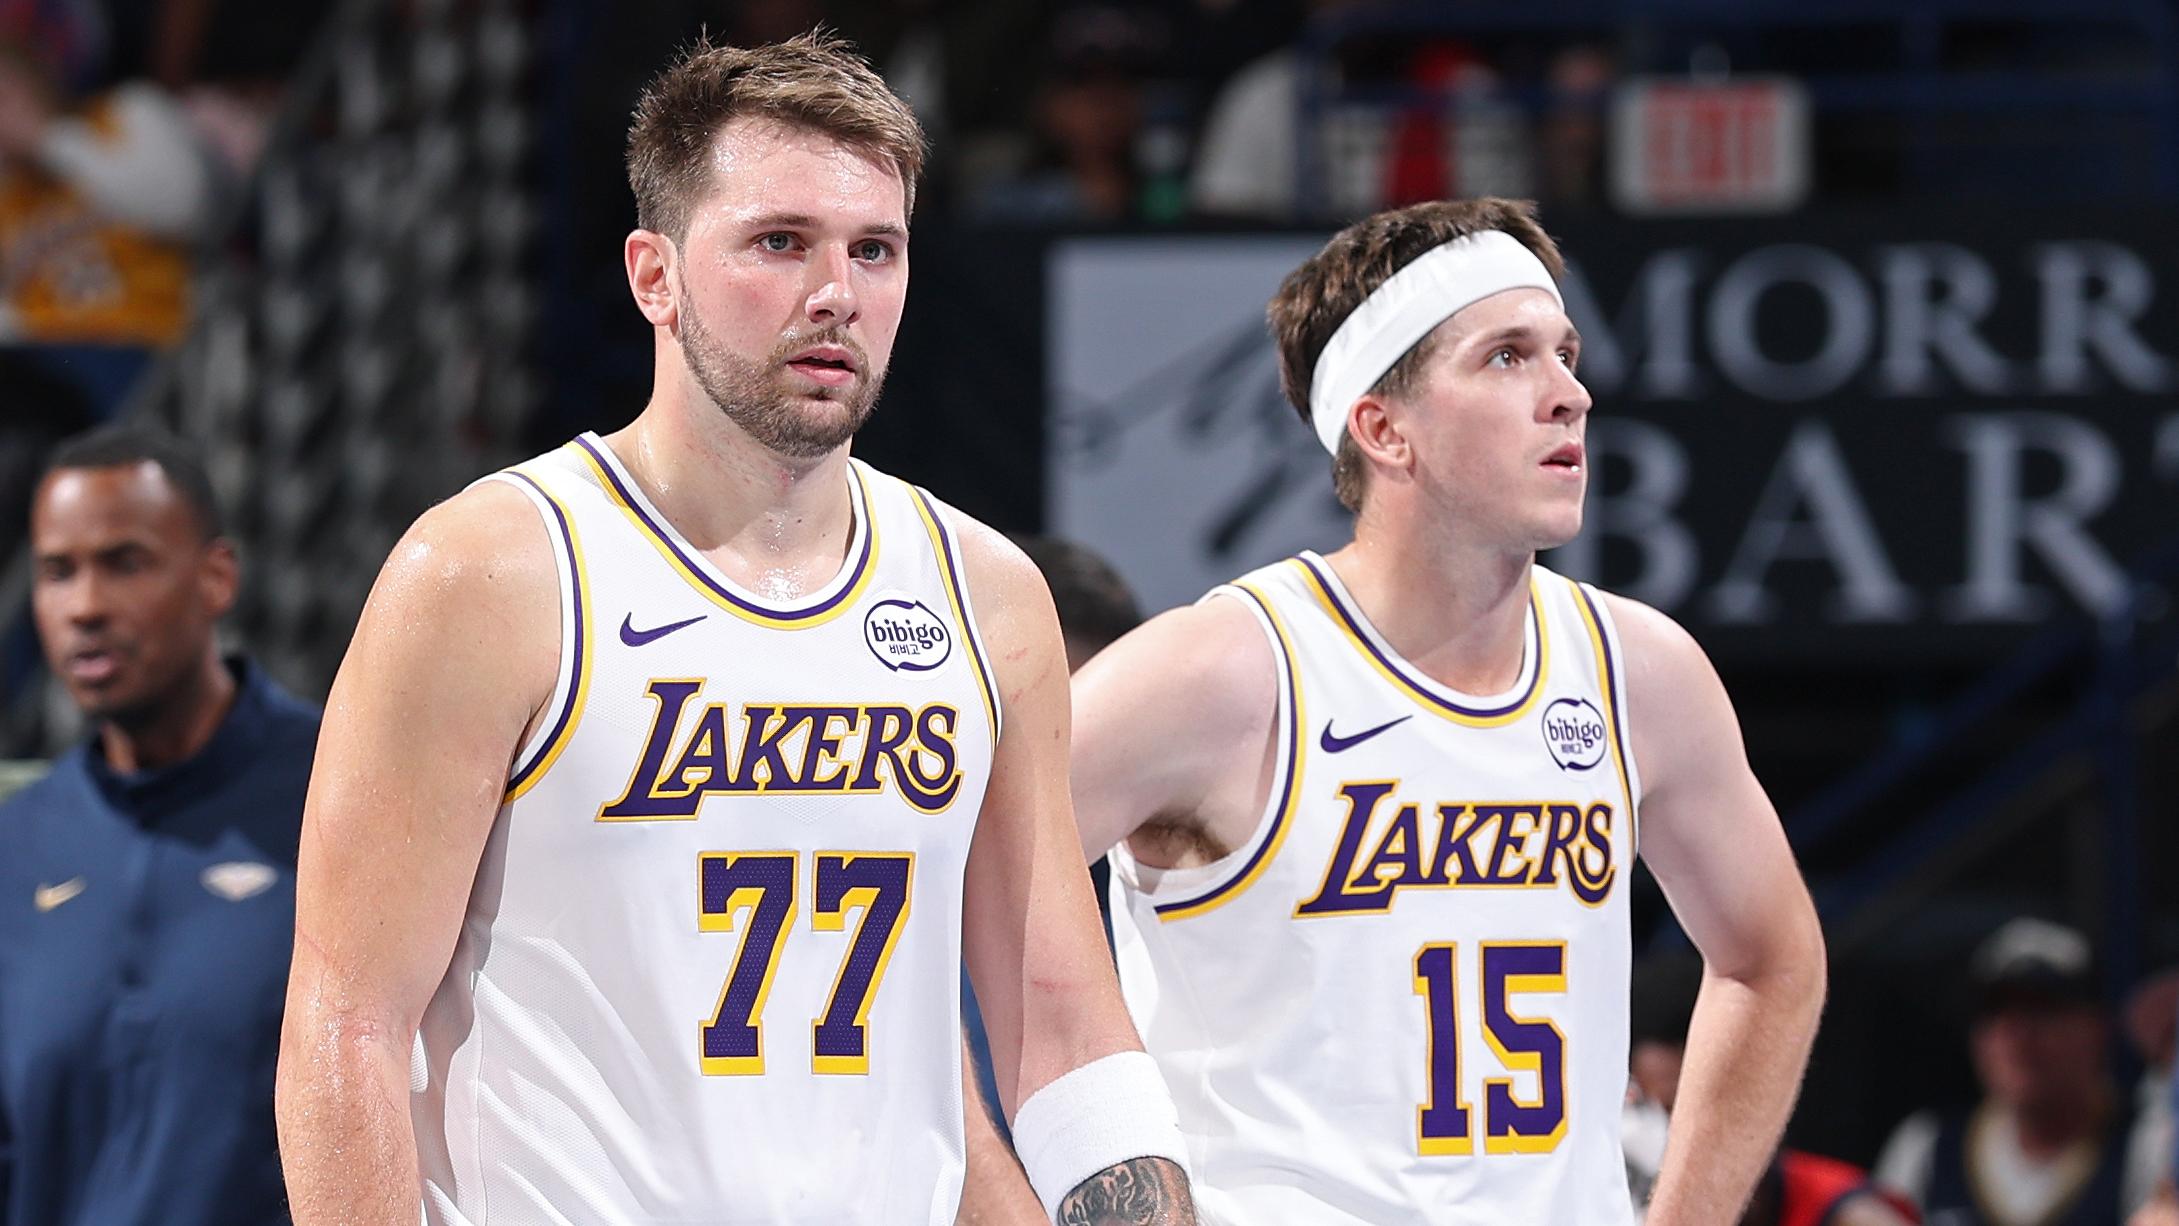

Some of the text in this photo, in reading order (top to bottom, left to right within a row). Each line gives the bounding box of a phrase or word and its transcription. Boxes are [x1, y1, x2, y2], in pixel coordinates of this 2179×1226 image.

[1552, 410, 2179, 622] BAR
[870, 618, 945, 650] bibigo
[888, 643, 921, 656] 비비고
[1547, 716, 1603, 749] bibigo
[697, 850, 916, 1076] 77
[1412, 940, 1568, 1156] 15
